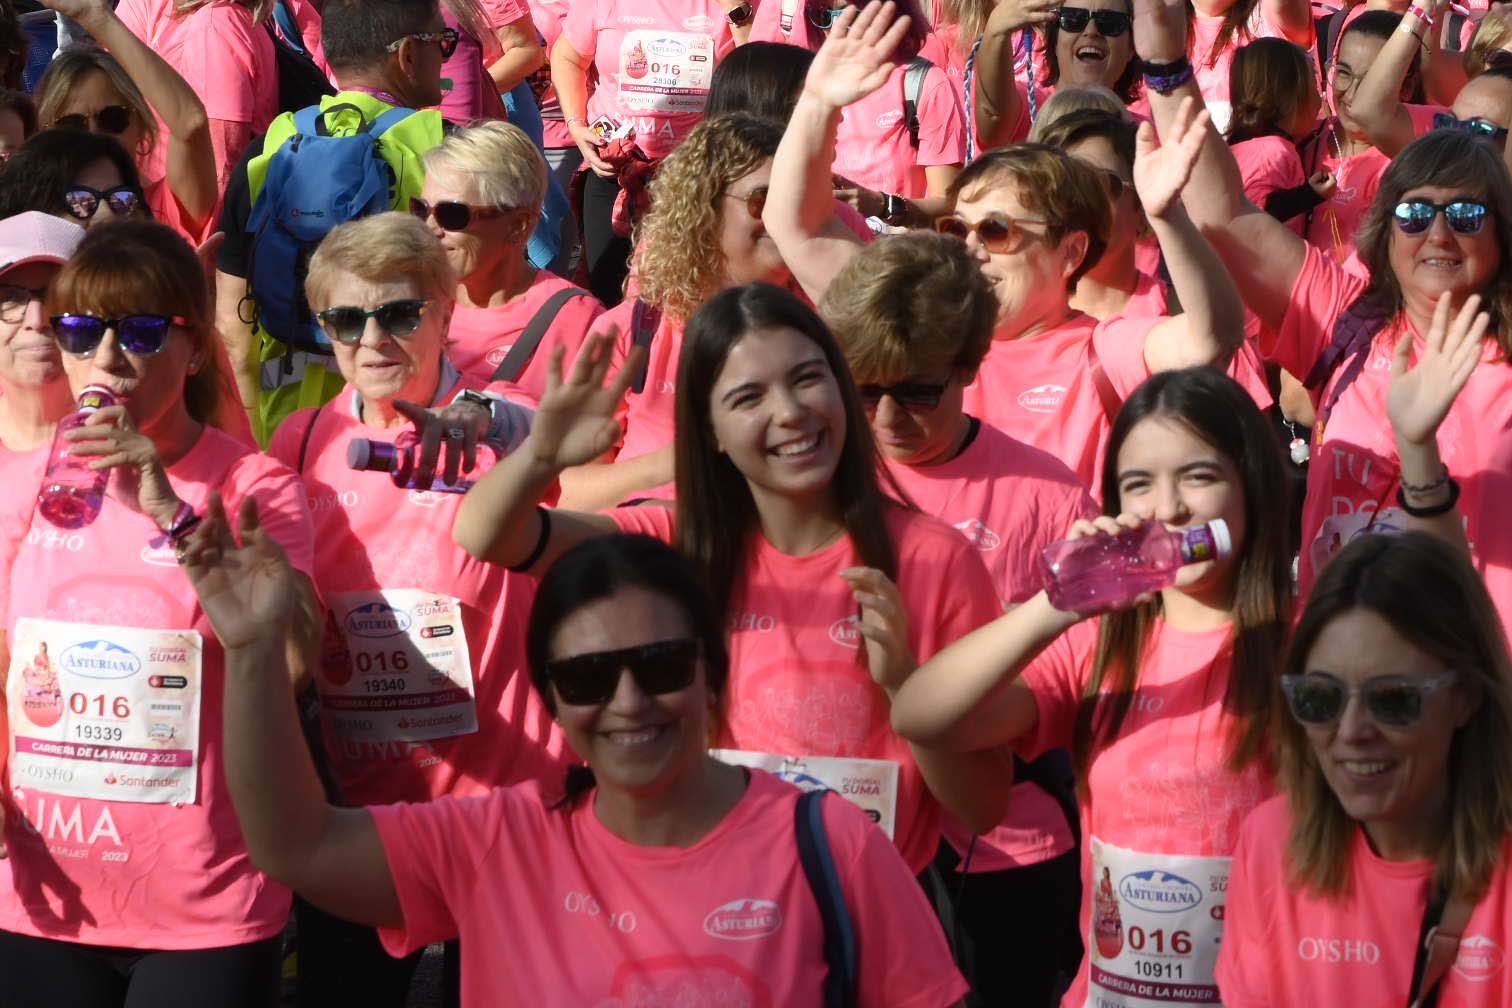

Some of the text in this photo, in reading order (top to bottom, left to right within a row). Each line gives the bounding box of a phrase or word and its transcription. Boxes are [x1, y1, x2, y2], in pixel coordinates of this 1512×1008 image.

[651, 62, 681, 76] 016
[416, 605, 450, 617] SUMA
[67, 653, 135, 672] ASTURIANA
[149, 652, 188, 664] SUMA
[356, 650, 410, 673] 016
[364, 677, 406, 693] 19340
[69, 692, 131, 719] 016
[75, 725, 123, 741] 19339
[31, 742, 76, 756] CARRERA
[76, 747, 92, 757] DE
[94, 748, 109, 759] LA
[109, 750, 148, 762] MUJER
[27, 763, 182, 788] OYSHO Santander
[842, 784, 881, 795] SUMA
[1124, 880, 1196, 904] ASTURIANA
[1128, 924, 1193, 956] 016
[1297, 935, 1381, 965] OYSHO
[1134, 958, 1184, 980] 10911
[1098, 973, 1214, 1000] CARRERA DE LA MUJER
